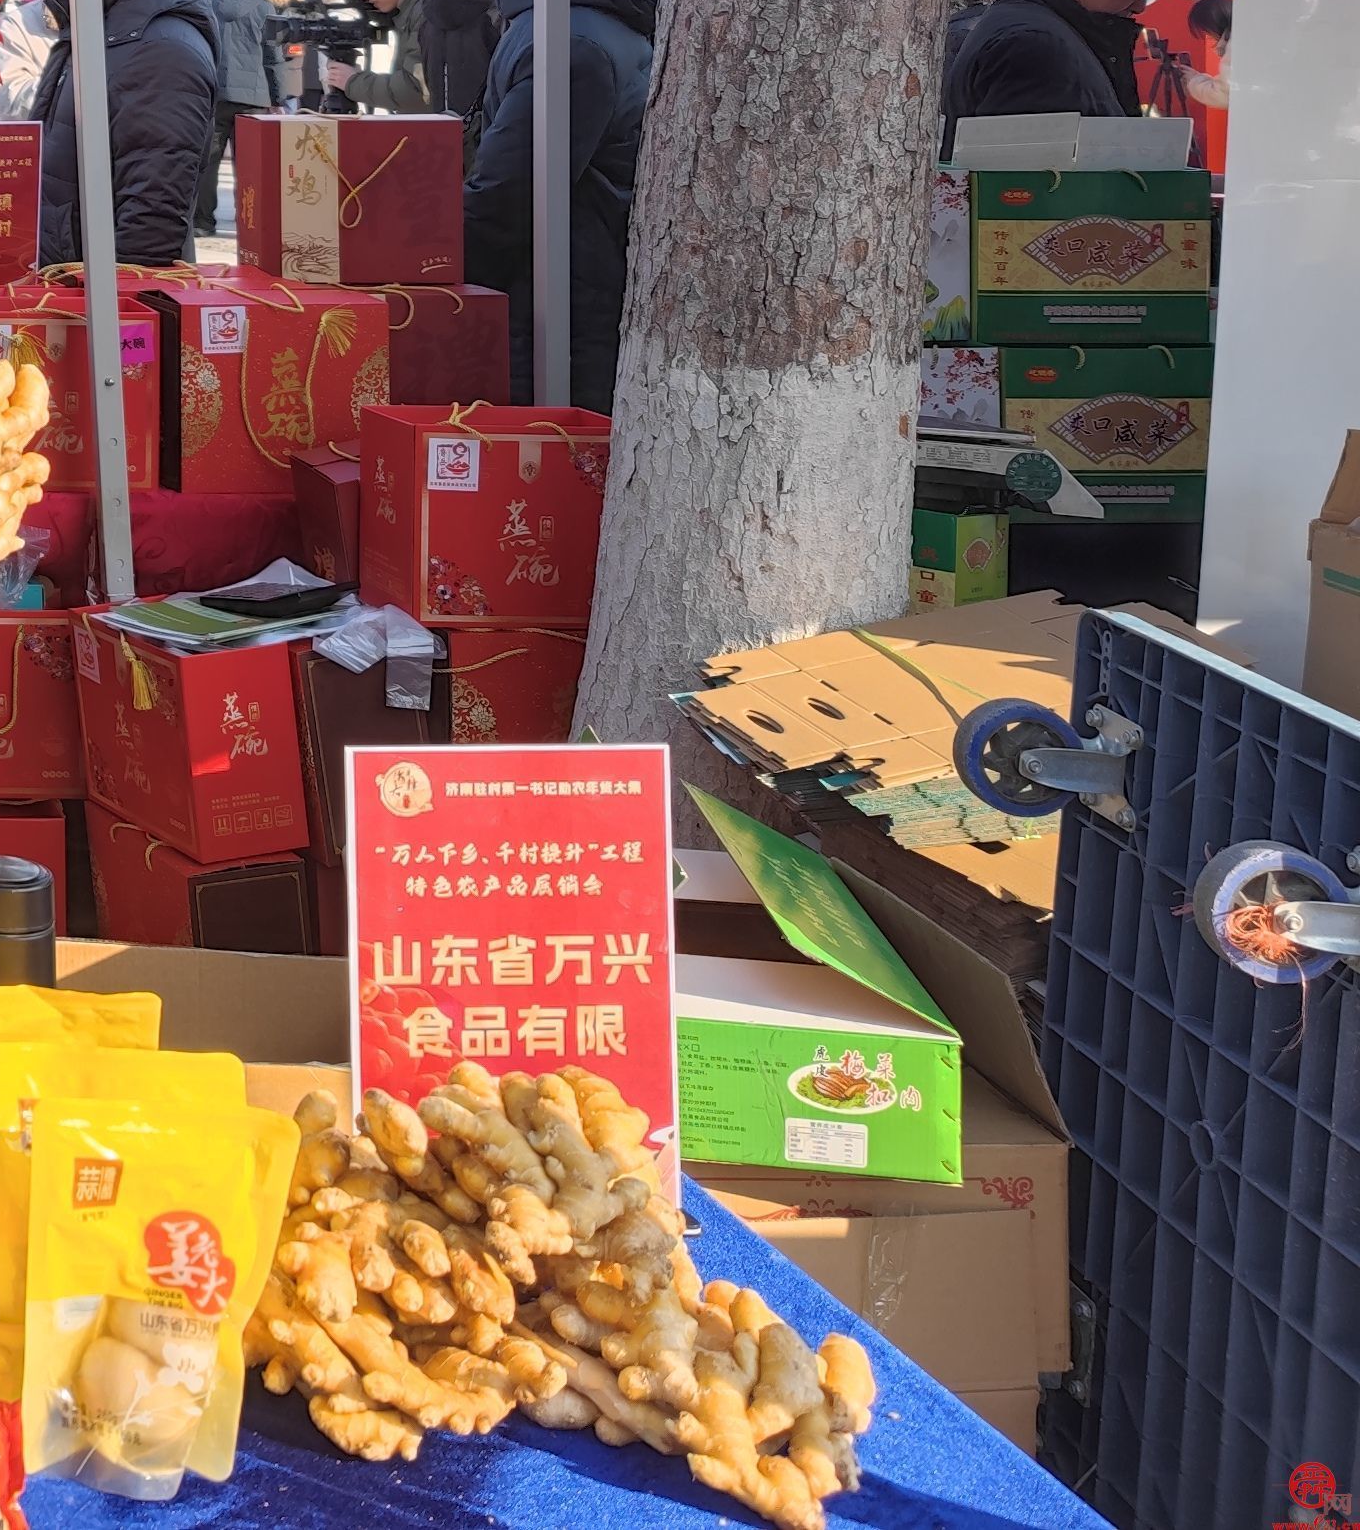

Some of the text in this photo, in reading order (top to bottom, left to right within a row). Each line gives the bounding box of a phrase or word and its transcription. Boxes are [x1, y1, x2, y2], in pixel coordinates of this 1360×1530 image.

[1043, 233, 1151, 269] 爽口咸菜
[1067, 413, 1180, 449] 爽口咸菜
[496, 498, 561, 587] 蒸碗
[219, 690, 269, 760] 蒸碗
[404, 873, 604, 898] 特色农产品展销会
[373, 932, 654, 988] 山东省万兴
[401, 1002, 629, 1059] 食品有限
